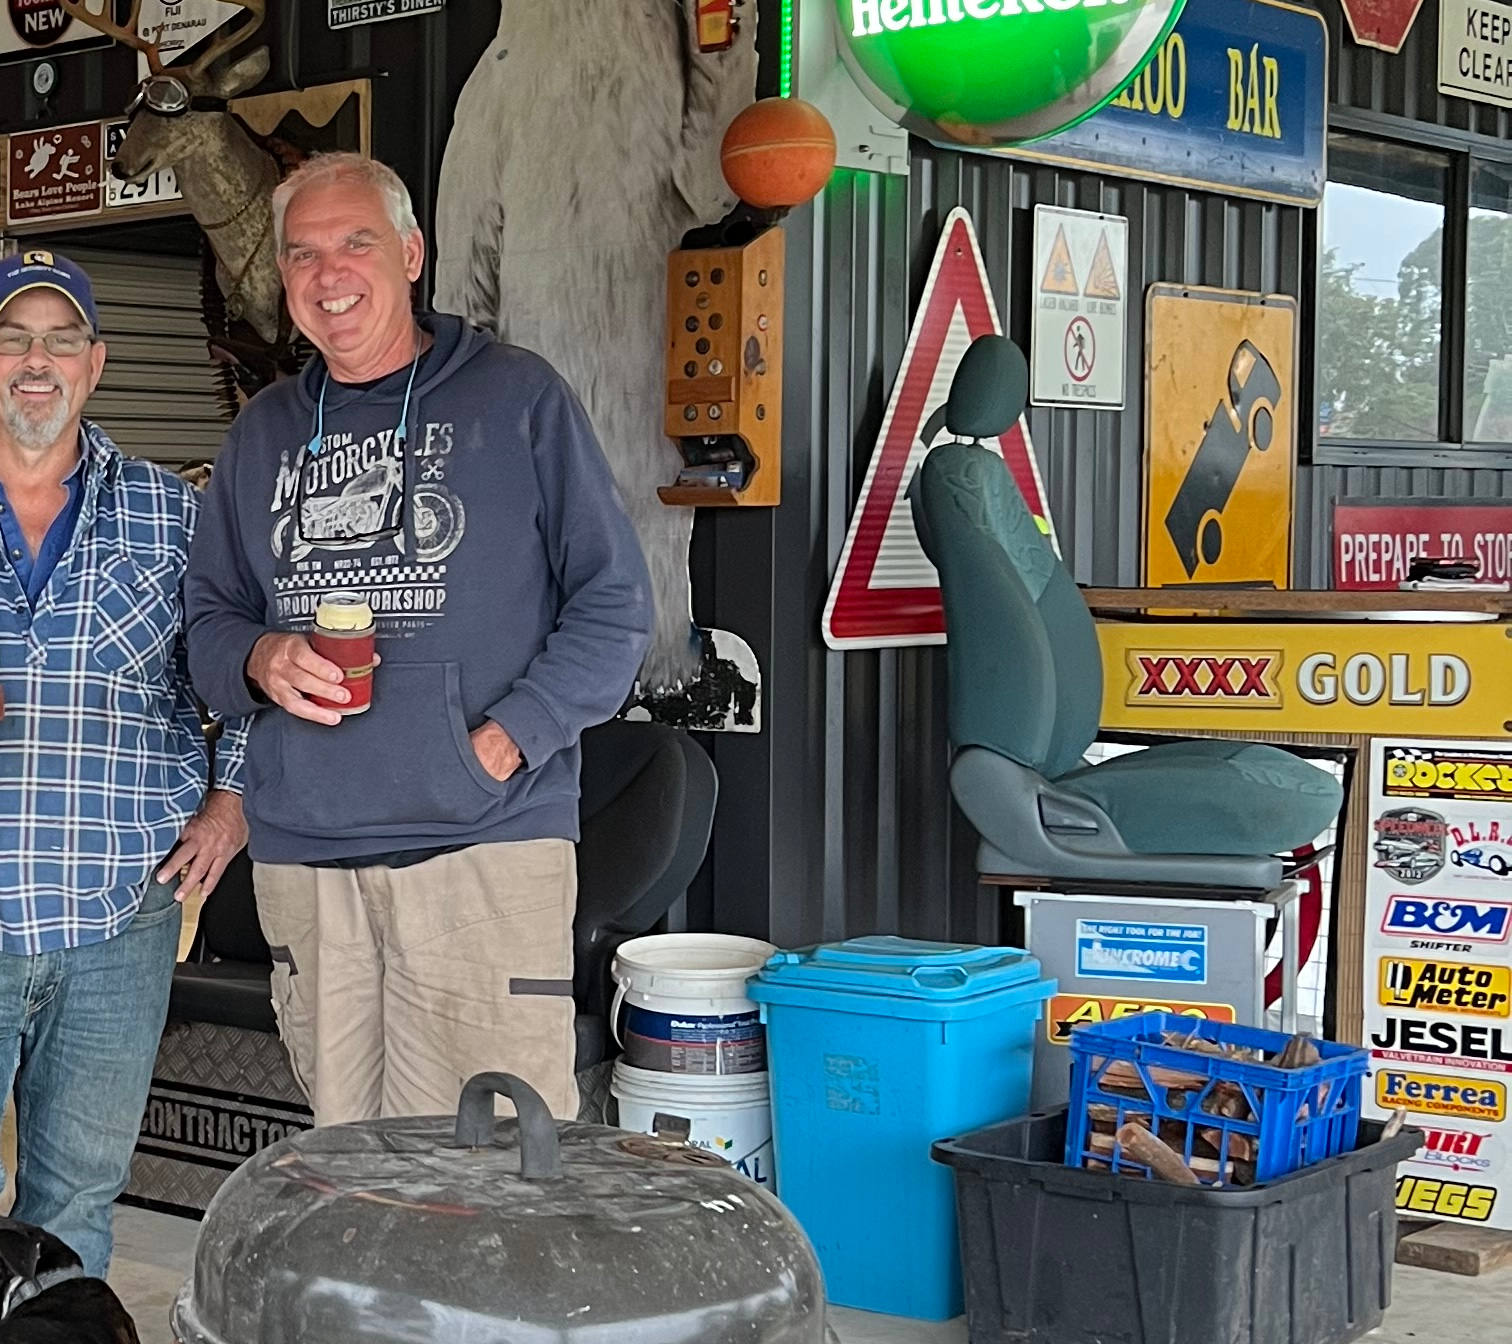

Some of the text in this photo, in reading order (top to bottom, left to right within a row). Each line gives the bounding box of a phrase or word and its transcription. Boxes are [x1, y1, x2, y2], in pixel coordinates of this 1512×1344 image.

[25, 8, 65, 34] NEW
[332, 0, 395, 24] THIRSTY'S
[1467, 7, 1512, 46] KEEP
[1227, 42, 1281, 139] BAR
[1474, 532, 1512, 580] STO
[1138, 652, 1472, 706] XXXX GOLD
[1388, 899, 1509, 936] B&M
[1098, 925, 1124, 936] RIGHT
[1125, 927, 1146, 937] TOOL
[1147, 928, 1164, 938] FOR
[1409, 940, 1473, 954] SHIFTER
[1417, 963, 1493, 989] Auto
[1412, 983, 1506, 1011] Meter
[1371, 1018, 1512, 1061] JESEL
[1380, 1050, 1506, 1073] VALVETRAIN INNOVATION
[1385, 1073, 1497, 1107] Ferrea
[1382, 1096, 1499, 1117] RACING COMPONENTS
[1424, 1151, 1491, 1168] BLOCKS
